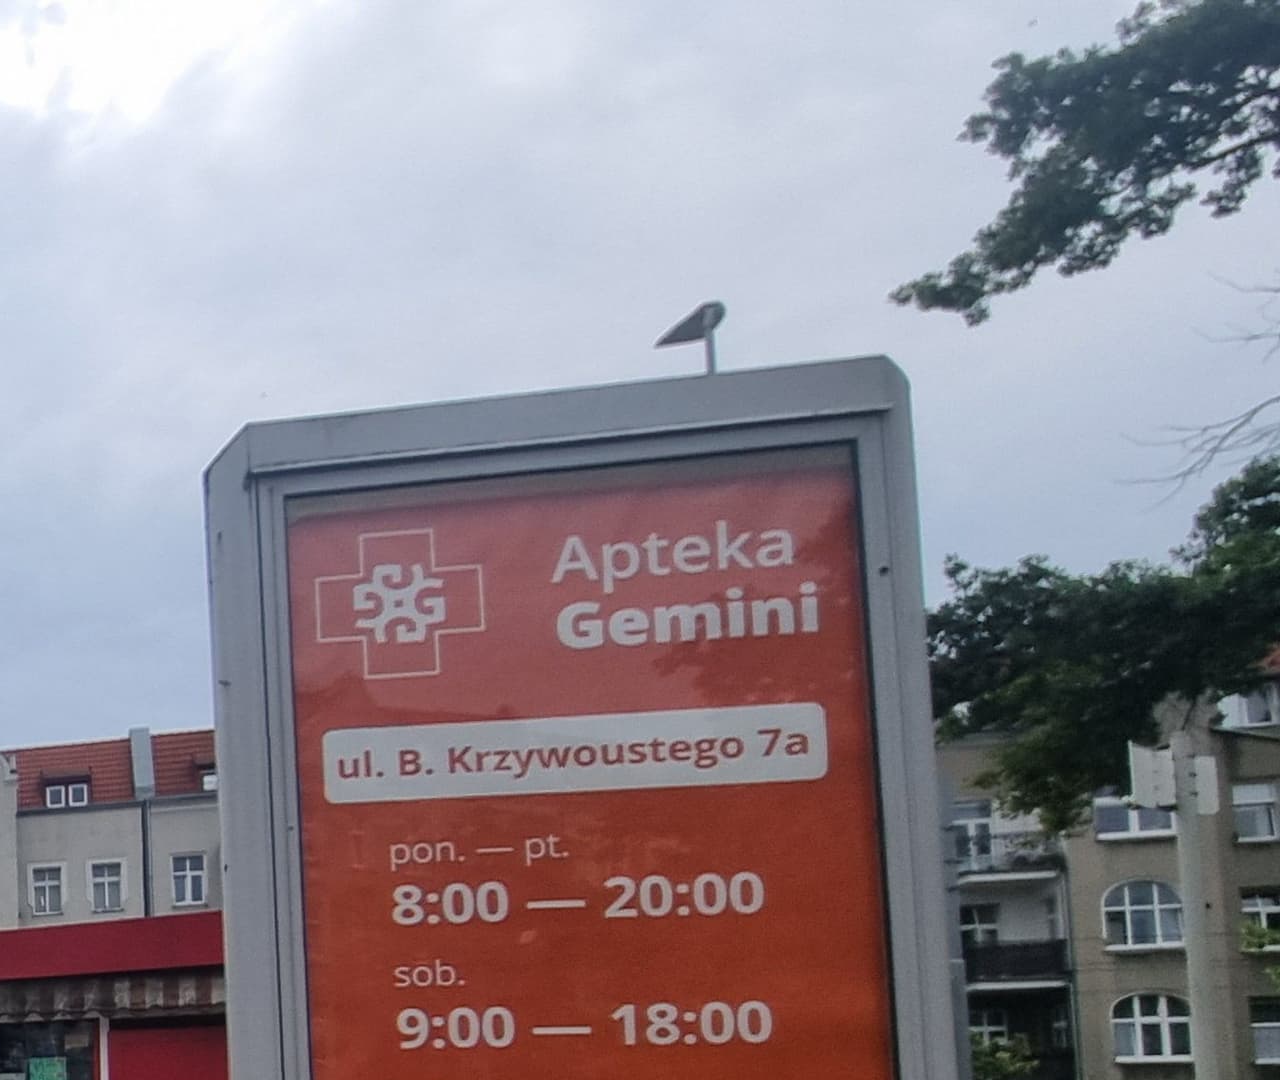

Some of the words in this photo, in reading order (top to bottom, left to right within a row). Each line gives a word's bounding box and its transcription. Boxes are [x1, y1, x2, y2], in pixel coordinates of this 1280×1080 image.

[550, 519, 794, 593] Apteka
[556, 580, 820, 650] Gemini
[336, 748, 385, 780] ul.
[397, 748, 435, 777] B.
[447, 733, 746, 783] Krzywoustego
[756, 727, 810, 758] 7a
[389, 838, 466, 872] pon.
[524, 833, 570, 867] pt.
[391, 880, 509, 926] 8:00
[602, 871, 765, 919] 20:00
[393, 958, 467, 988] sob.
[395, 1005, 516, 1050] 9:00
[610, 1000, 774, 1046] 18:00
